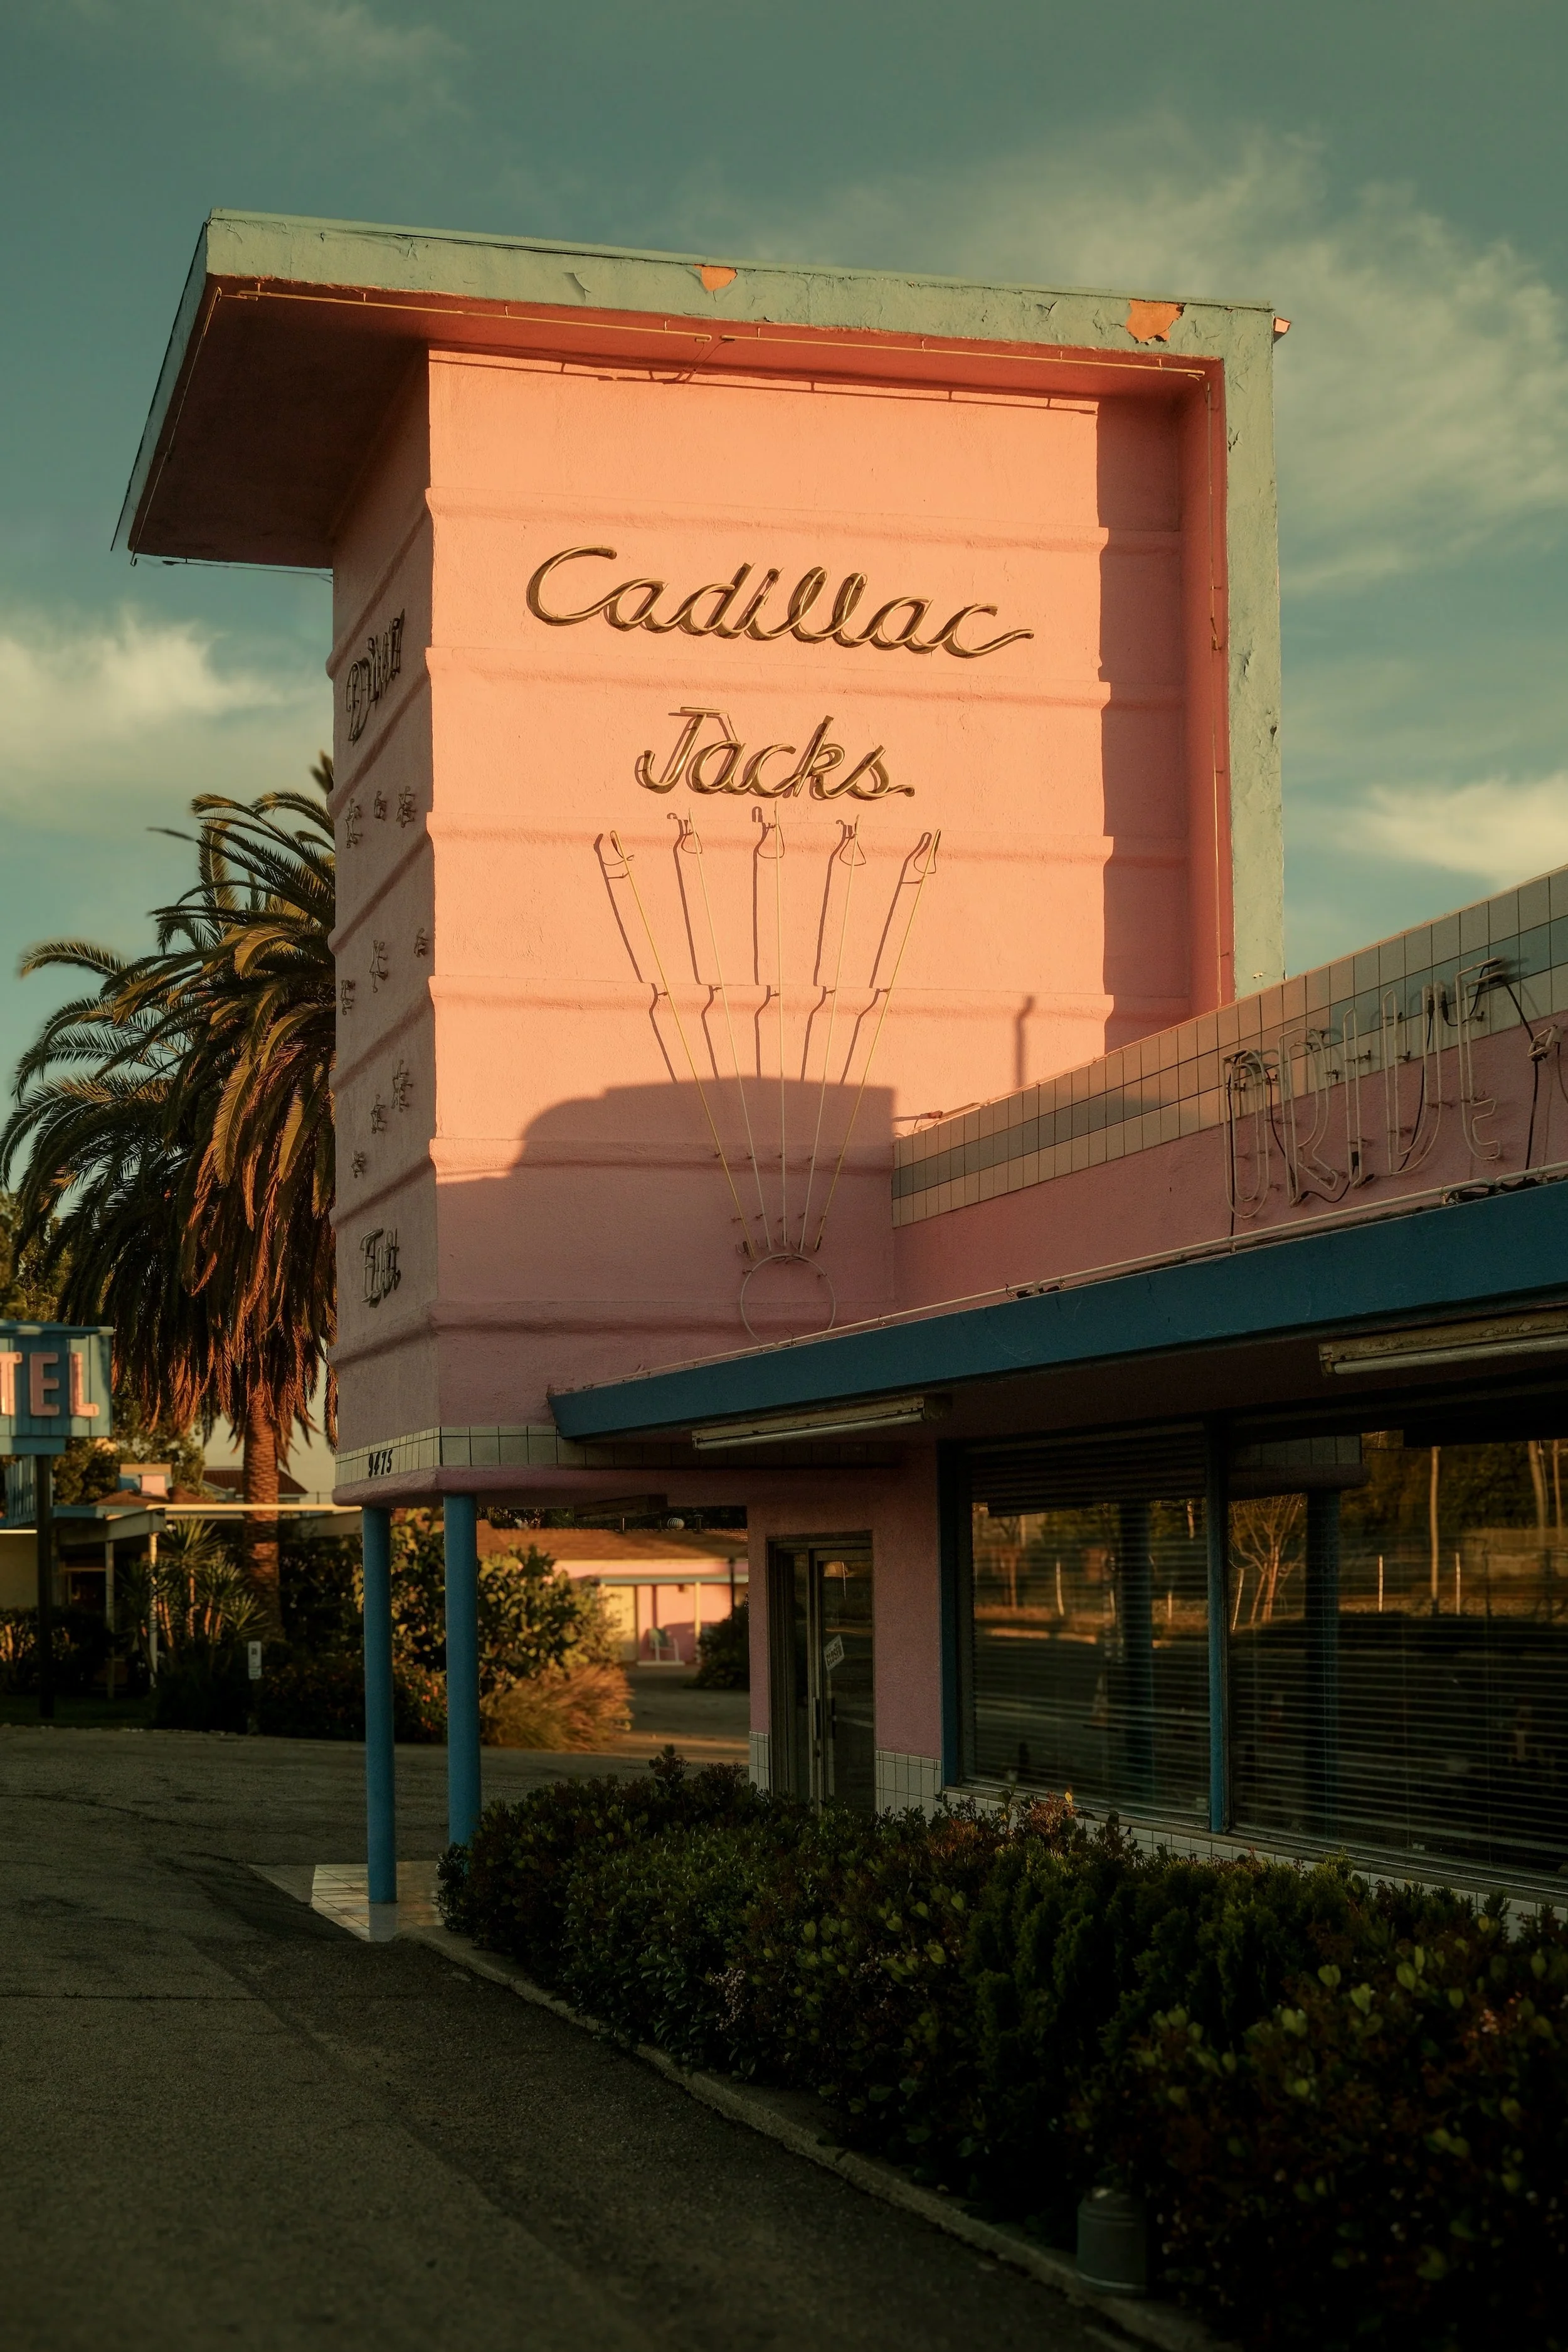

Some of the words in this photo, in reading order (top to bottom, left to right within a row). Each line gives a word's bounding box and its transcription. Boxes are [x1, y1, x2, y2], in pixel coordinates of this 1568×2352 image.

[526, 545, 1034, 657] Cadillac
[637, 706, 916, 800] Jacks
[0, 1352, 99, 1417] TEL
[368, 1449, 393, 1478] 9475
[825, 1644, 842, 1667] CLOSED
